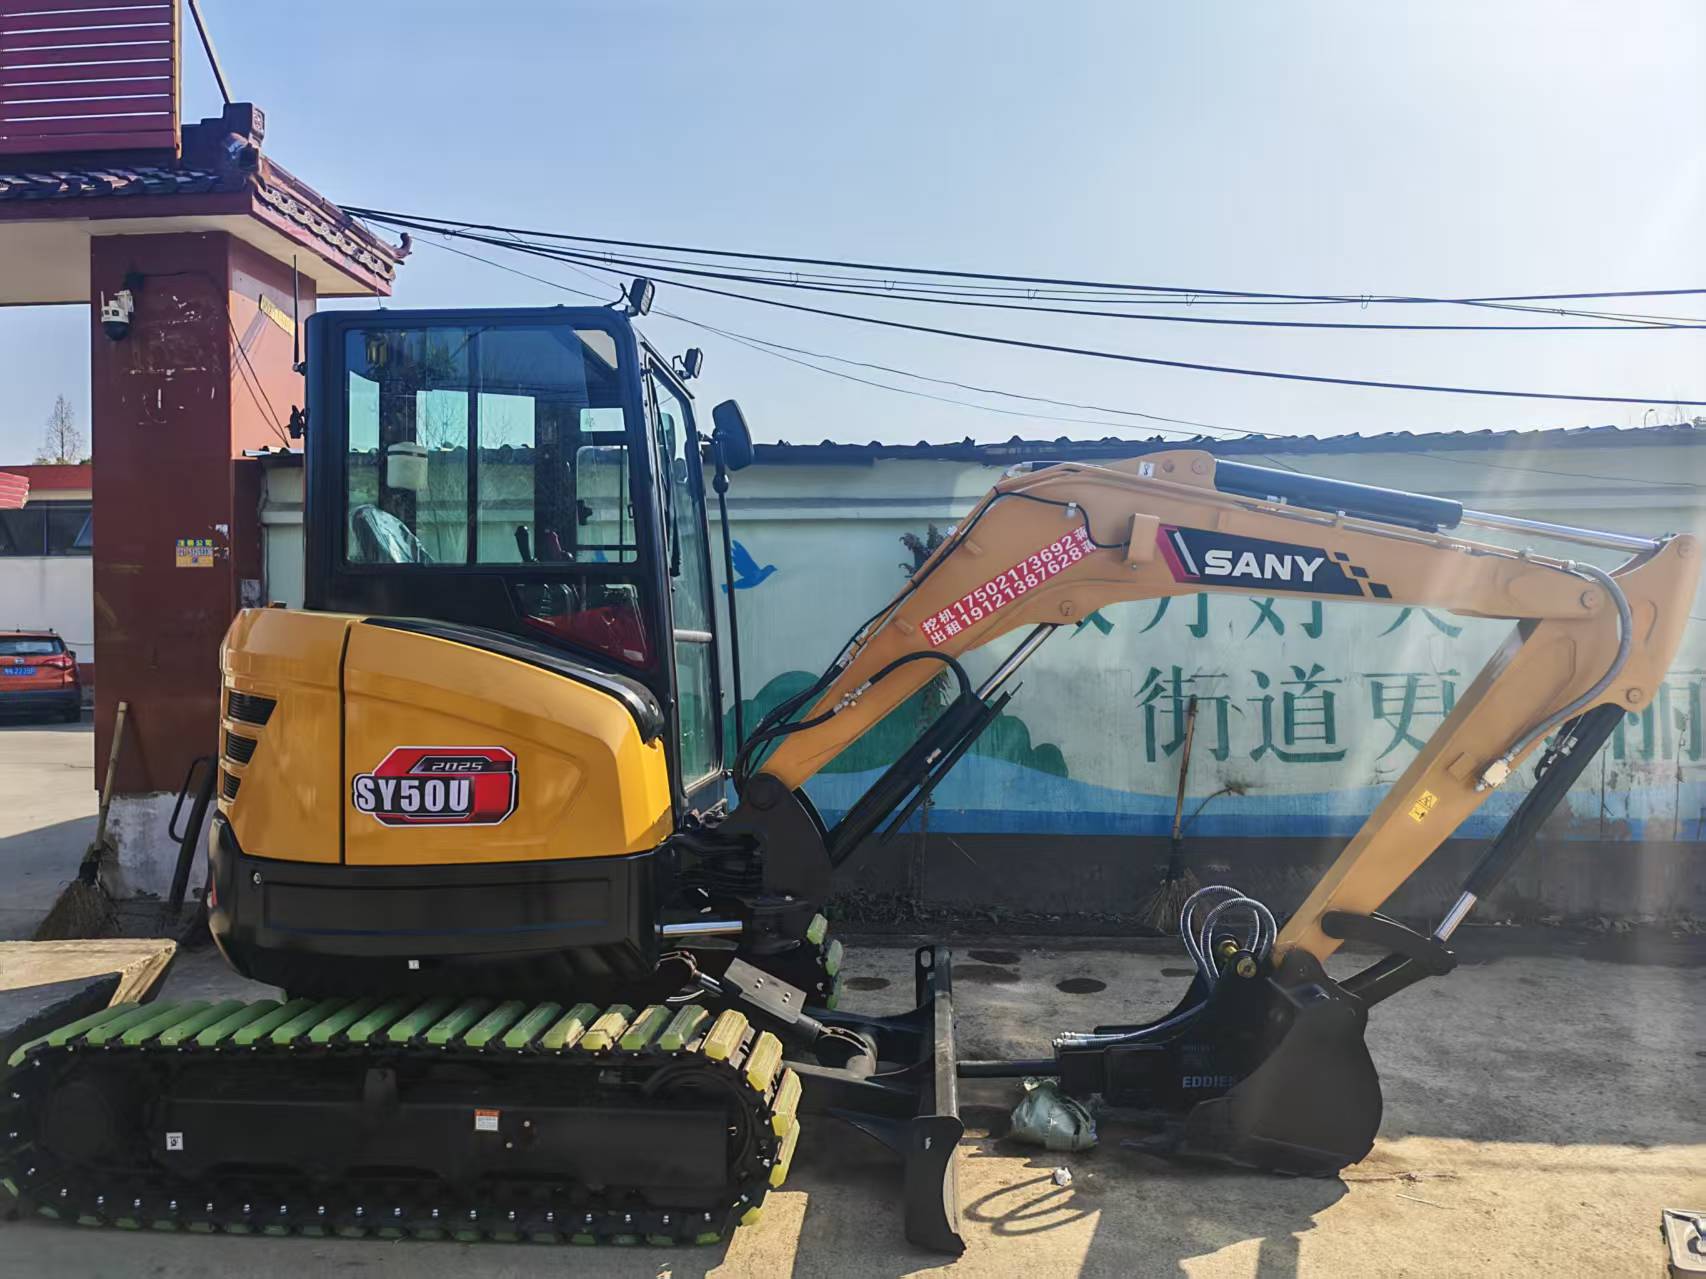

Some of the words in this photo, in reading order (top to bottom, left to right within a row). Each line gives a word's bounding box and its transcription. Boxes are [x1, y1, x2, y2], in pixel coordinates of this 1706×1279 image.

[1204, 549, 1325, 582] SANY
[431, 761, 484, 772] 2025
[357, 778, 470, 812] SY50U
